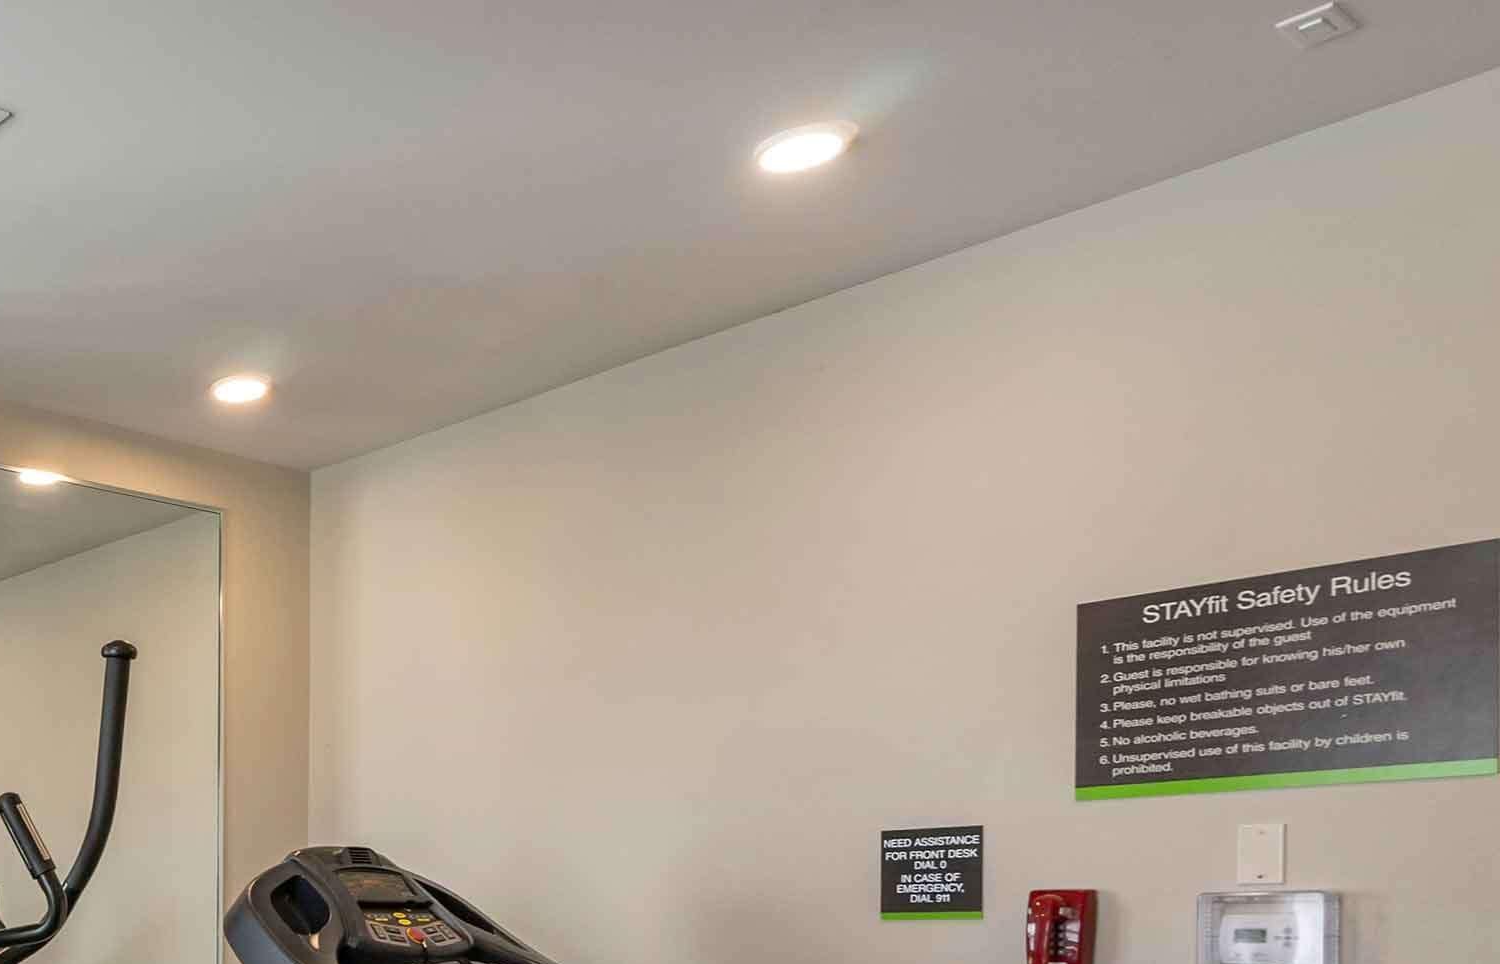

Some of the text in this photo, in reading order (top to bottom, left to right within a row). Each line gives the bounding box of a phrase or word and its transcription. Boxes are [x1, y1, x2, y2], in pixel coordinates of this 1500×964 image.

[1142, 571, 1412, 623] STAYfit Safety Rules
[1101, 644, 1111, 654] 1.
[1113, 640, 1139, 653] This
[1143, 635, 1180, 649] facility
[1183, 633, 1194, 643] is
[1197, 630, 1218, 642] not
[1300, 616, 1329, 628] Use
[1332, 611, 1347, 624] of
[1350, 608, 1373, 621] the
[1377, 598, 1458, 619] equipment
[1113, 629, 1312, 665] is the responsibility of the guest
[1100, 638, 1407, 684] 2. Guest is responsible for knowing his/her own
[1100, 702, 1112, 713] 3.
[1160, 696, 1176, 707] no
[1179, 693, 1202, 704] wet
[1204, 686, 1253, 702] bathing
[1255, 683, 1287, 697] suits
[1290, 682, 1305, 693] or
[1308, 679, 1341, 692] bare
[1112, 672, 1227, 696] physical limitations
[1100, 720, 1112, 730] 4.
[1113, 717, 1154, 729] Please
[1156, 713, 1187, 726] keep
[1190, 703, 1253, 722] breakable
[1256, 700, 1305, 716] objects
[1308, 697, 1331, 710] out
[1334, 694, 1349, 707] of
[1100, 724, 1260, 748] 5. No alcoholic beverages.
[1100, 729, 1410, 766] 6. Unsupervised use of this facility by children is
[1112, 761, 1173, 778] prohibited.
[883, 834, 980, 848] NEED ASSISTANCE
[885, 848, 979, 861] FOR FRONT DESK
[913, 860, 948, 870] DIAL 0
[900, 872, 962, 883] IN CASE OF
[909, 894, 951, 903] DIAL 911
